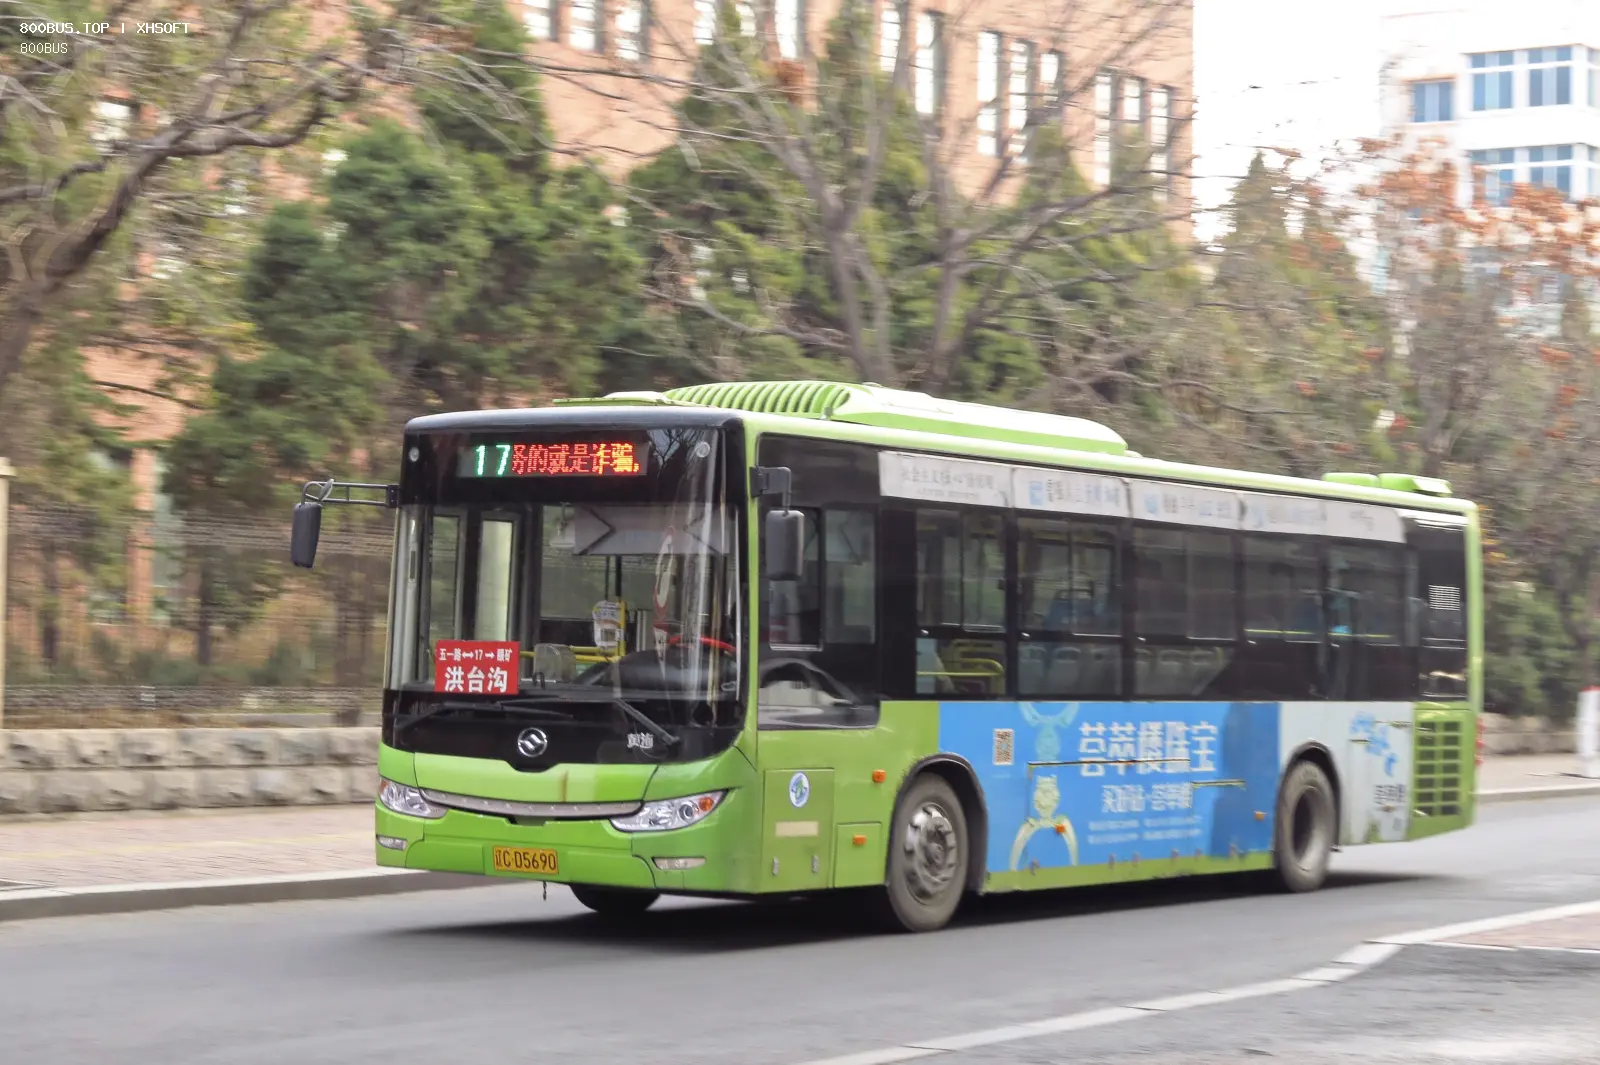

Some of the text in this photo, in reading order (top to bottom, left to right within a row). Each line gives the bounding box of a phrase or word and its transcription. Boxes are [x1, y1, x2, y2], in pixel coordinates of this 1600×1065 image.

[475, 444, 511, 476] 17
[474, 648, 484, 661] 17
[444, 665, 508, 693] 洪台沟
